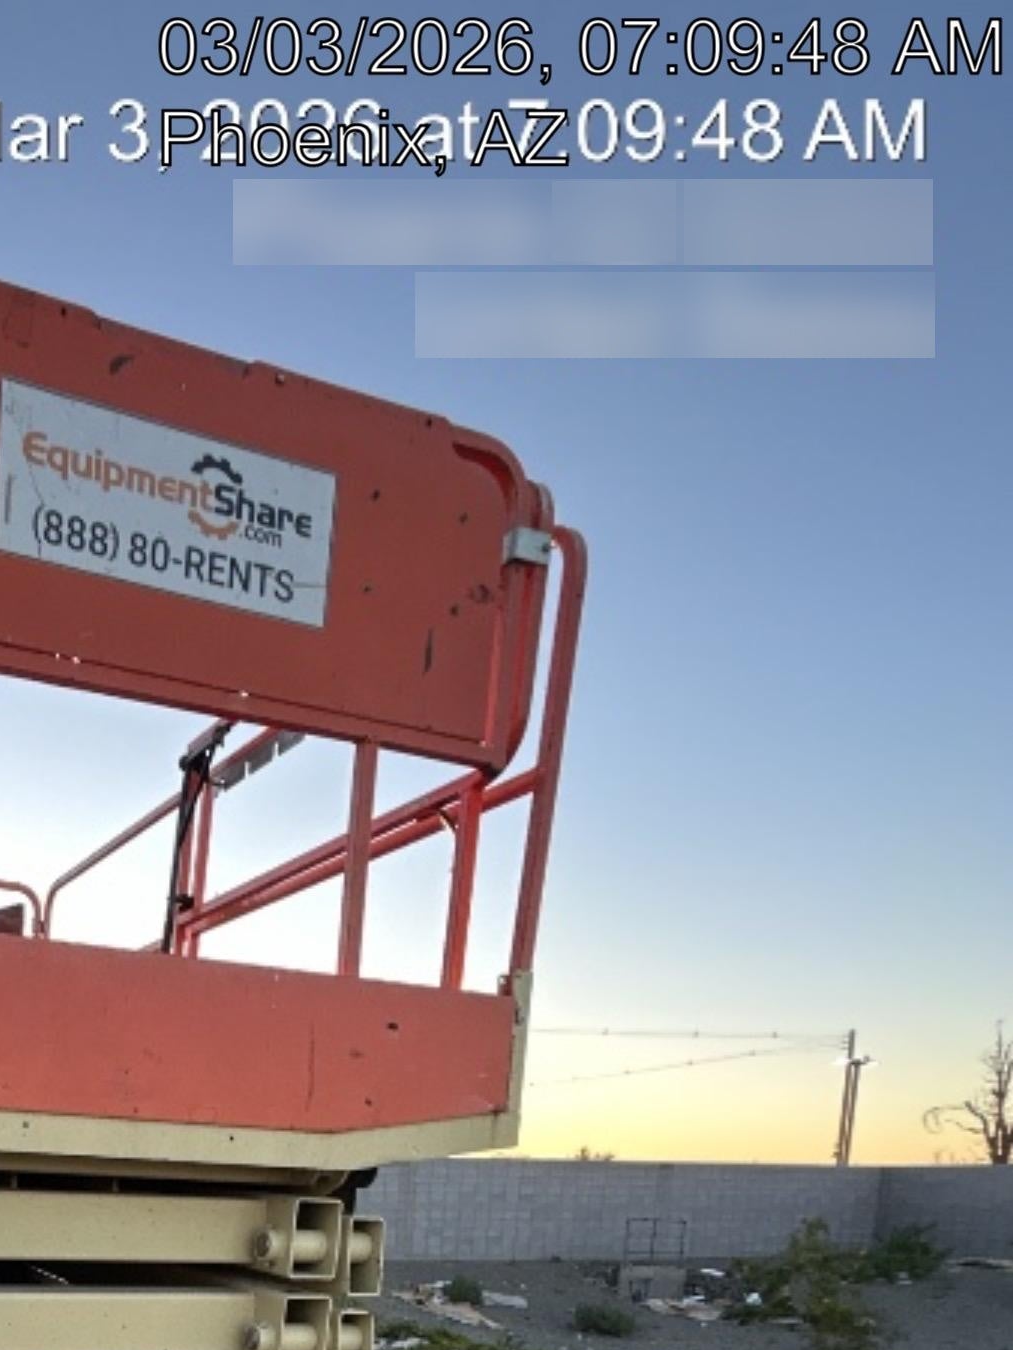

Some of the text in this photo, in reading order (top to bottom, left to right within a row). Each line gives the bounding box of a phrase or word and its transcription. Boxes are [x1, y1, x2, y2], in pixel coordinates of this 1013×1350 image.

[21, 431, 313, 539] EquipmentShare
[32, 505, 295, 604] (888) 80-RENTS
[238, 523, 282, 549] .com
